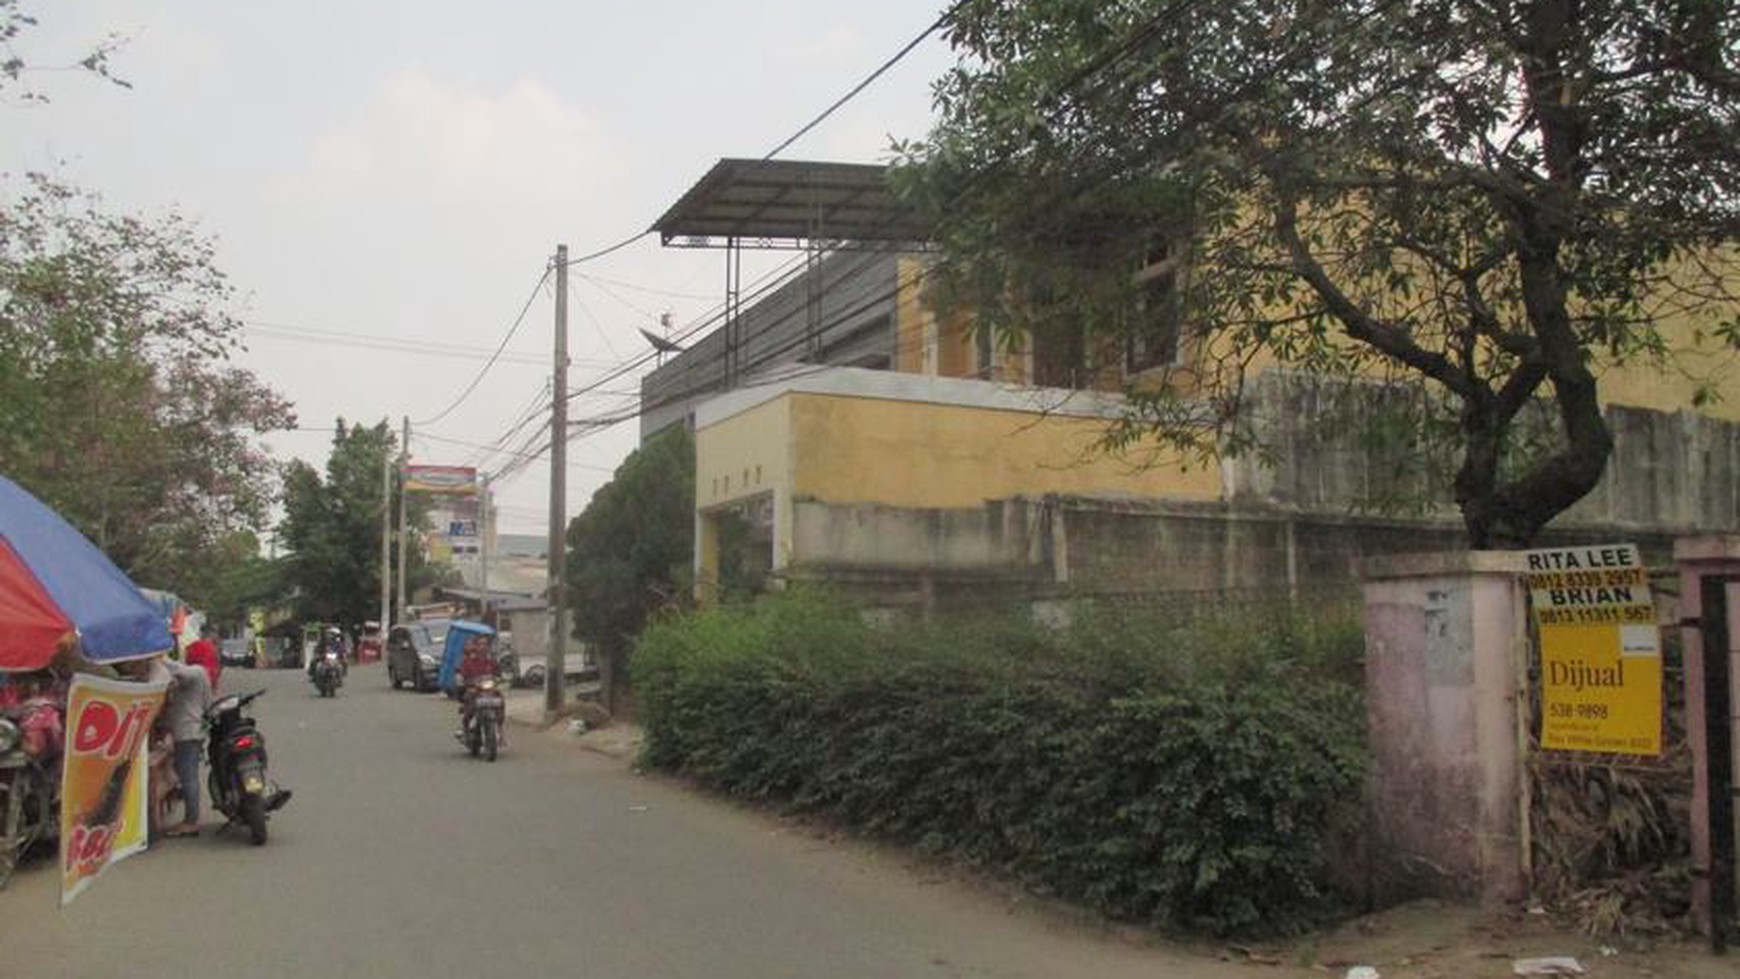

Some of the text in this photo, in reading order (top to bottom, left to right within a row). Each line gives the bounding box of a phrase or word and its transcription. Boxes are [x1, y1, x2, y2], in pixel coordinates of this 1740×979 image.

[1527, 548, 1633, 571] RITA LEE
[1550, 587, 1633, 605] BRIAN
[1549, 659, 1624, 692] Dijual
